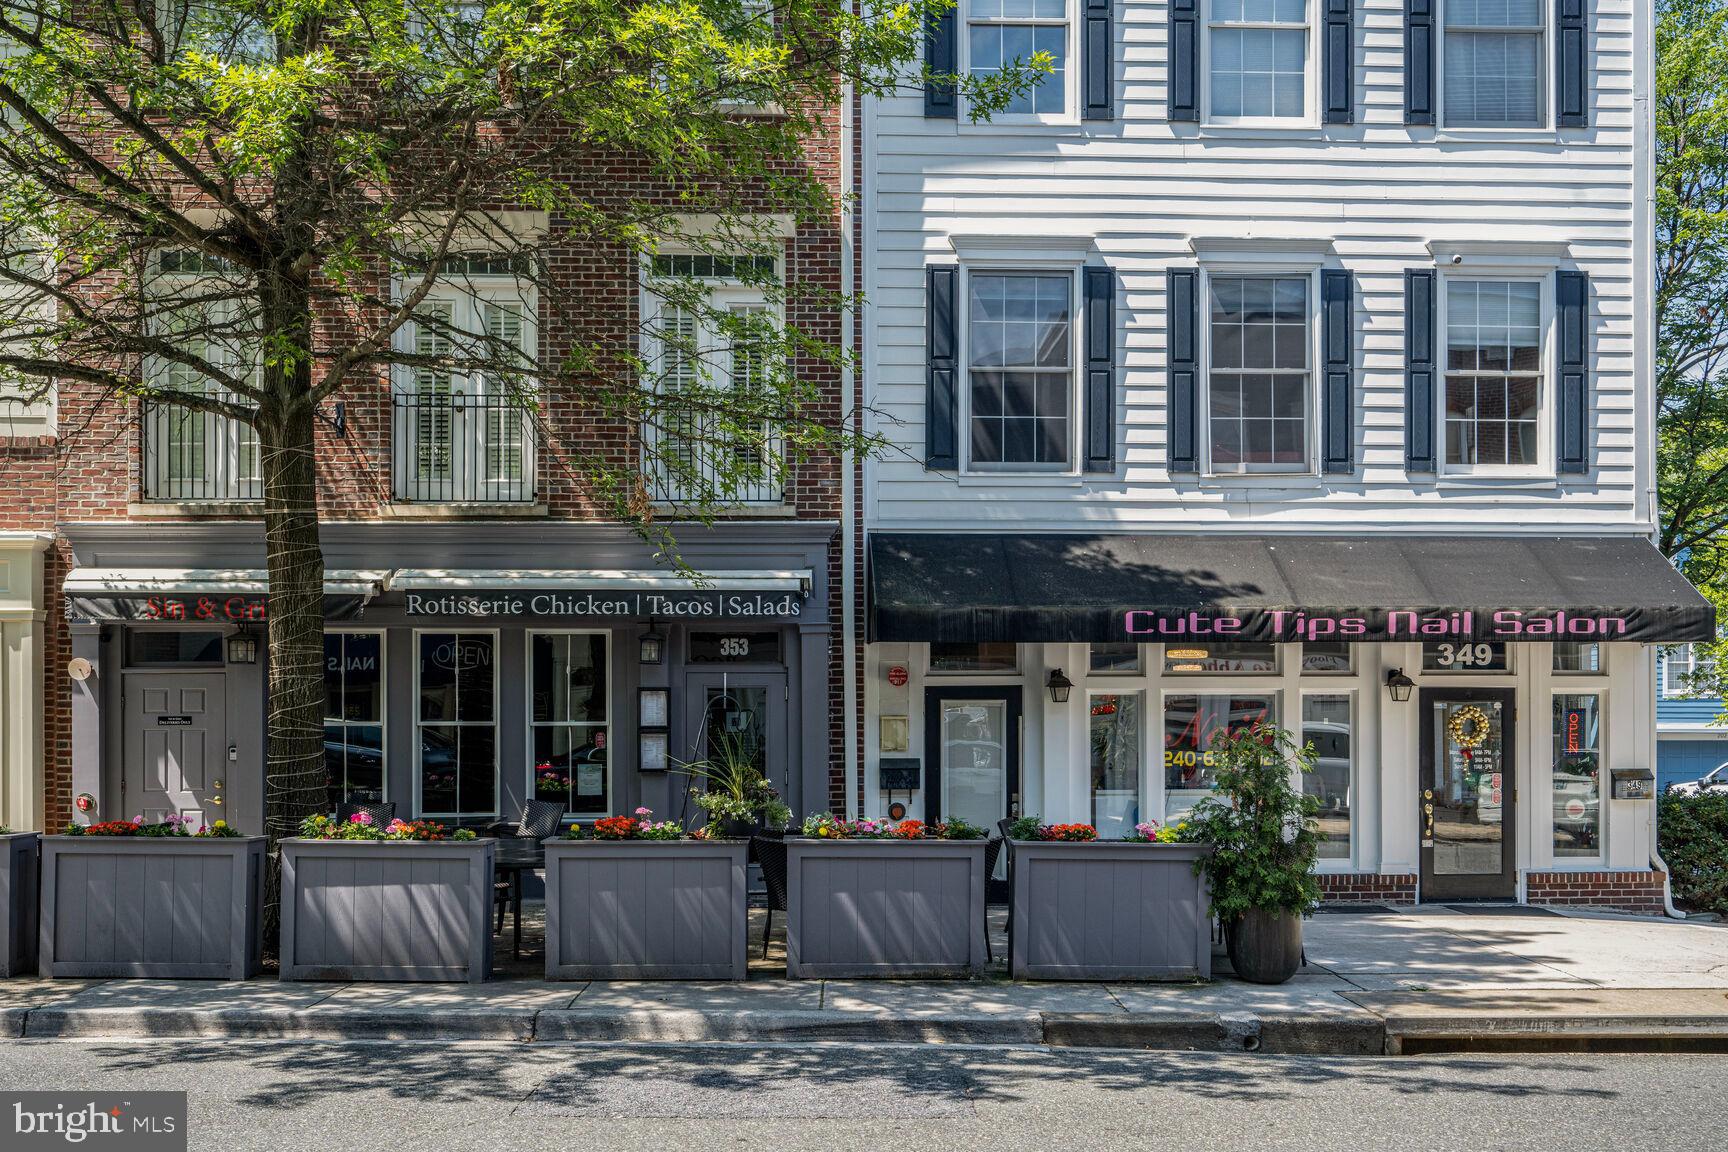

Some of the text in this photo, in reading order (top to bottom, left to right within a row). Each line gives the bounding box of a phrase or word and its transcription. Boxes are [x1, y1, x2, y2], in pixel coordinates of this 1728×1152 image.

[147, 596, 266, 620] Sin & Gri
[406, 594, 523, 616] Rotisserie
[530, 594, 630, 616] Chicken
[647, 595, 713, 616] Tacos
[728, 595, 801, 616] Salads
[1125, 610, 1626, 641] Cute Tips Nail Salon
[436, 643, 490, 666] OPEN
[720, 638, 749, 656] 353
[1437, 643, 1493, 666] 349
[1569, 713, 1579, 754] OPEN
